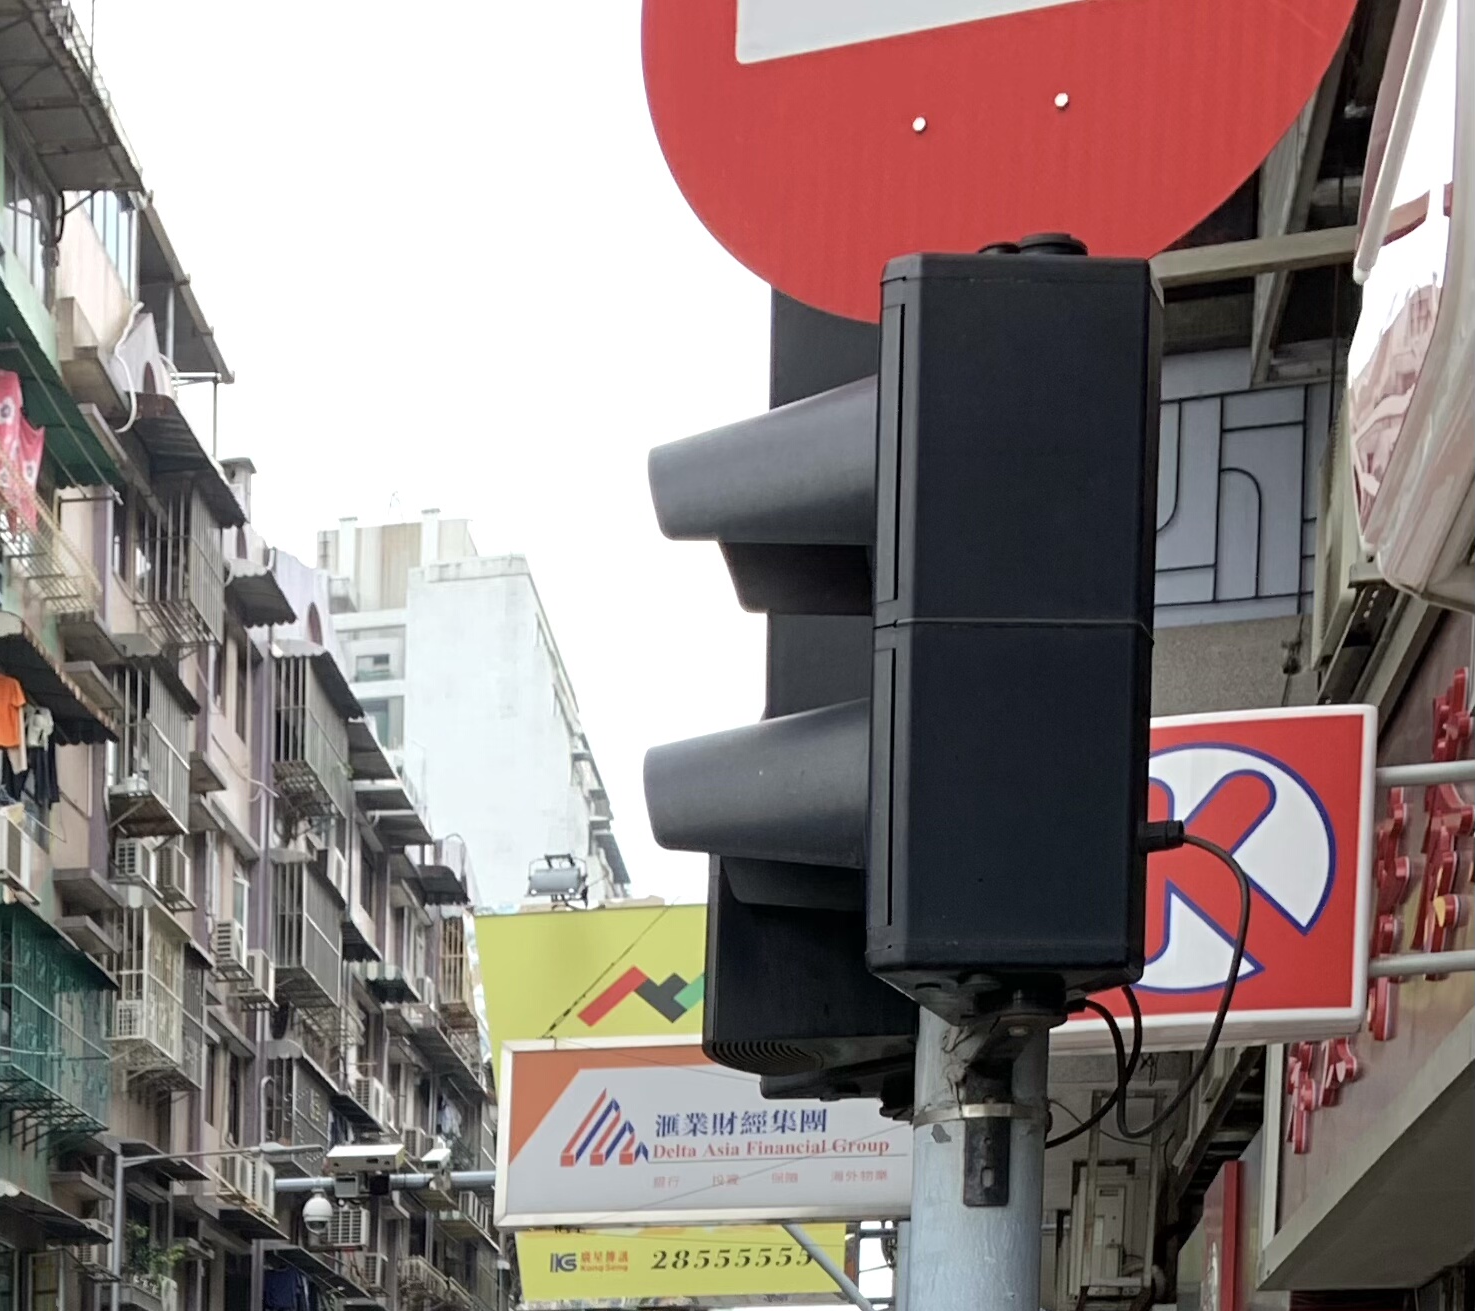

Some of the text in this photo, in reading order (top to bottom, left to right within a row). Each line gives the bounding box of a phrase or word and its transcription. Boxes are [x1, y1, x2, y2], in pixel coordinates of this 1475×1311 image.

[653, 1138, 889, 1159] Delta Asia Financial Group
